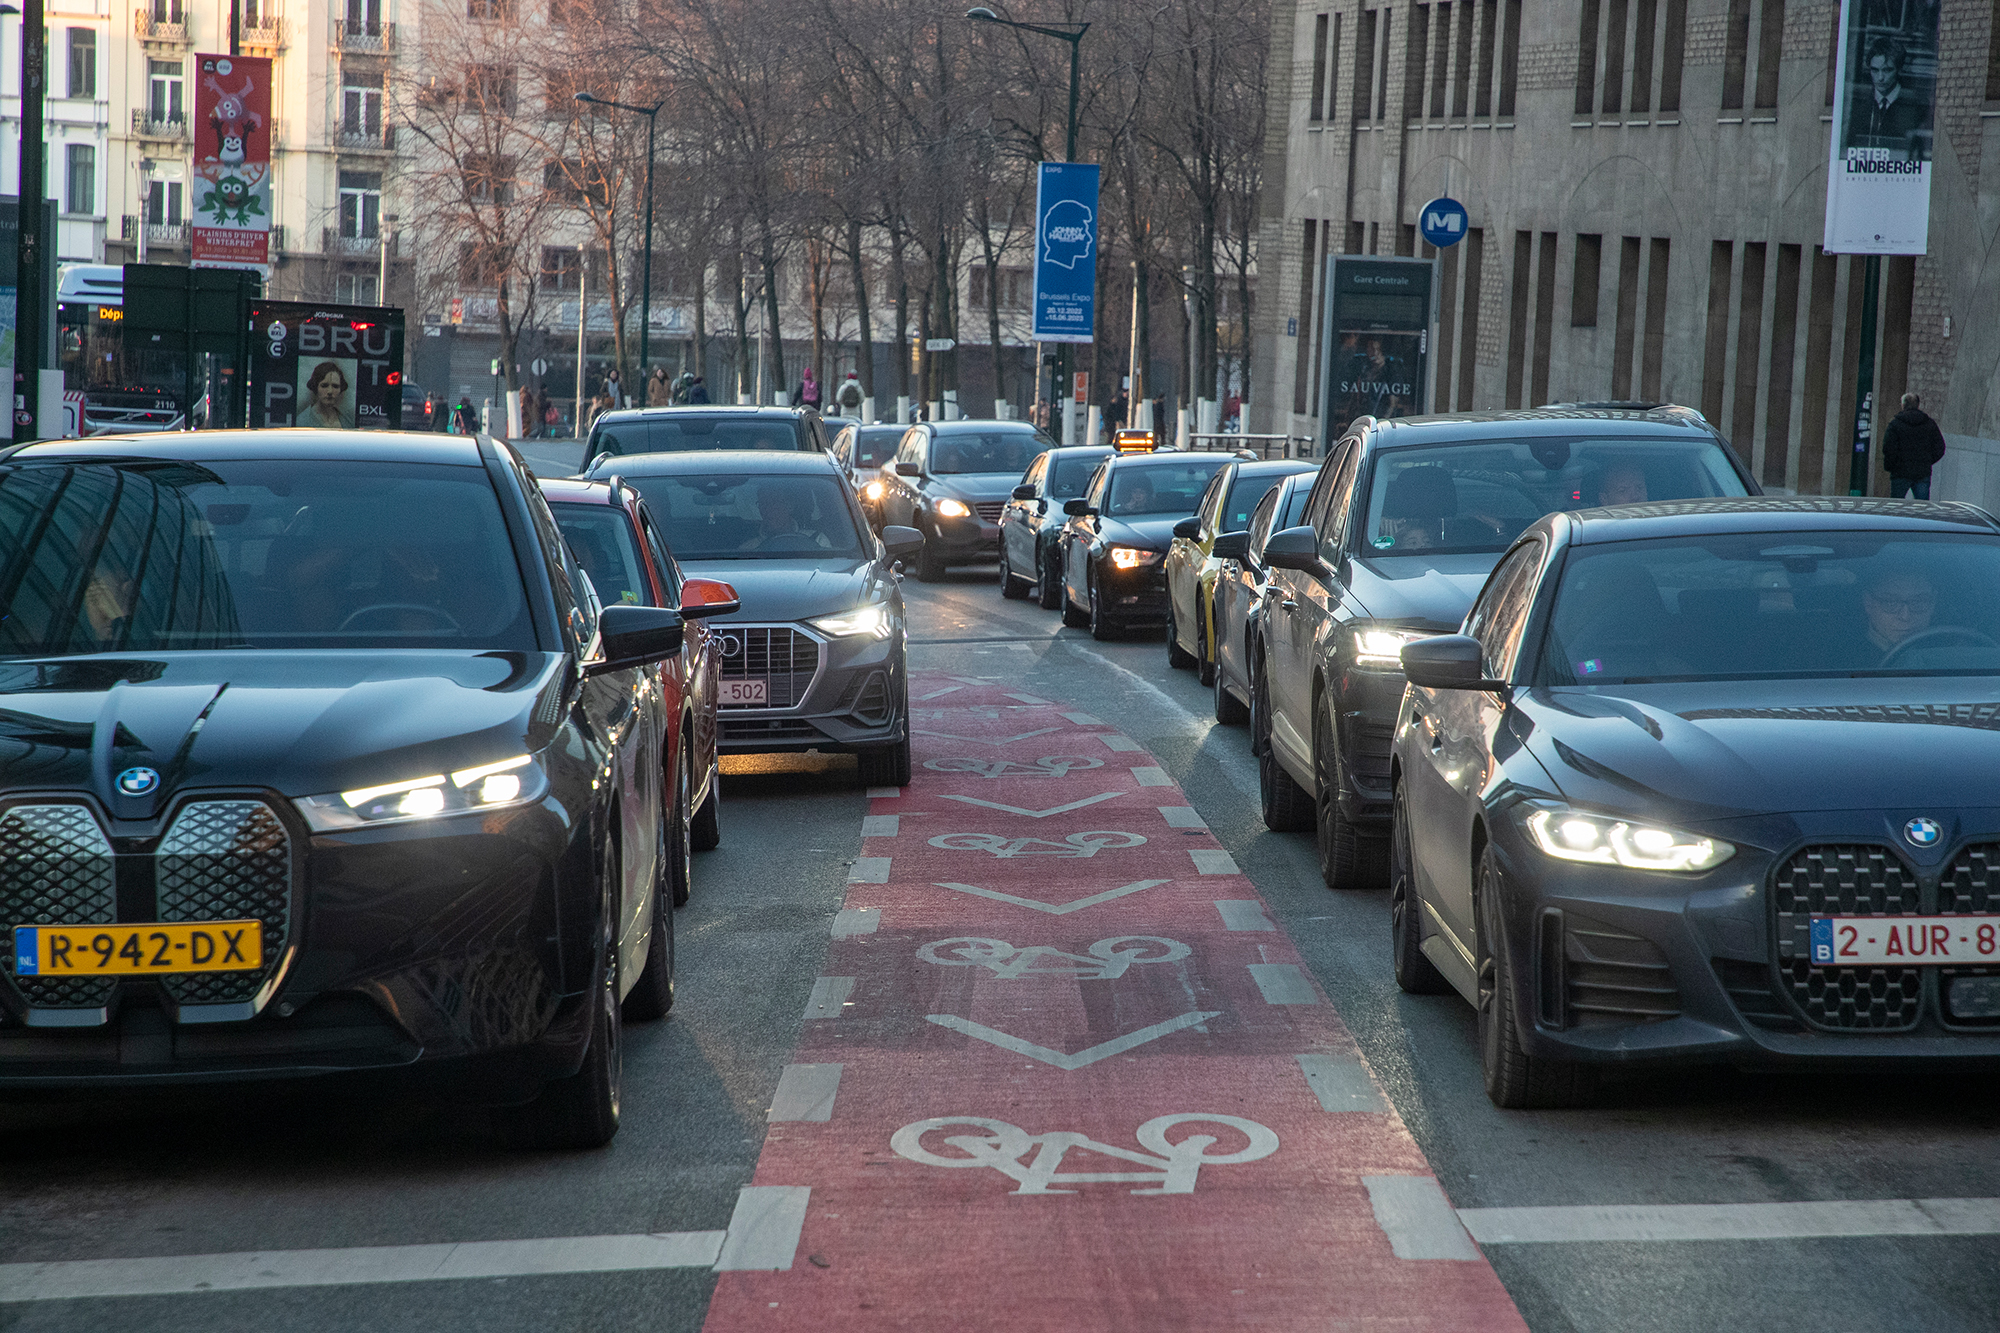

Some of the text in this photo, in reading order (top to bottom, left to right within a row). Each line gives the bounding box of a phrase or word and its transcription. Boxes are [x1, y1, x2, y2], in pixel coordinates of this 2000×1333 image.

[1847, 147, 1890, 160] PETER
[1846, 160, 1922, 174] LINDBERGH
[197, 229, 264, 240] PLAISIRS D'HIVER
[207, 238, 255, 247] WINTERPRET
[1354, 275, 1409, 285] Gare Centrale
[1040, 292, 1091, 302] Brussels Expo
[1341, 381, 1411, 395] SAUVAGE
[155, 400, 175, 410] 2110
[359, 404, 387, 416] BXL
[1838, 923, 2000, 956] 2-AUR-8
[50, 929, 246, 969] R-942-DX
[1816, 945, 1831, 960] B
[19, 956, 36, 967] NL
